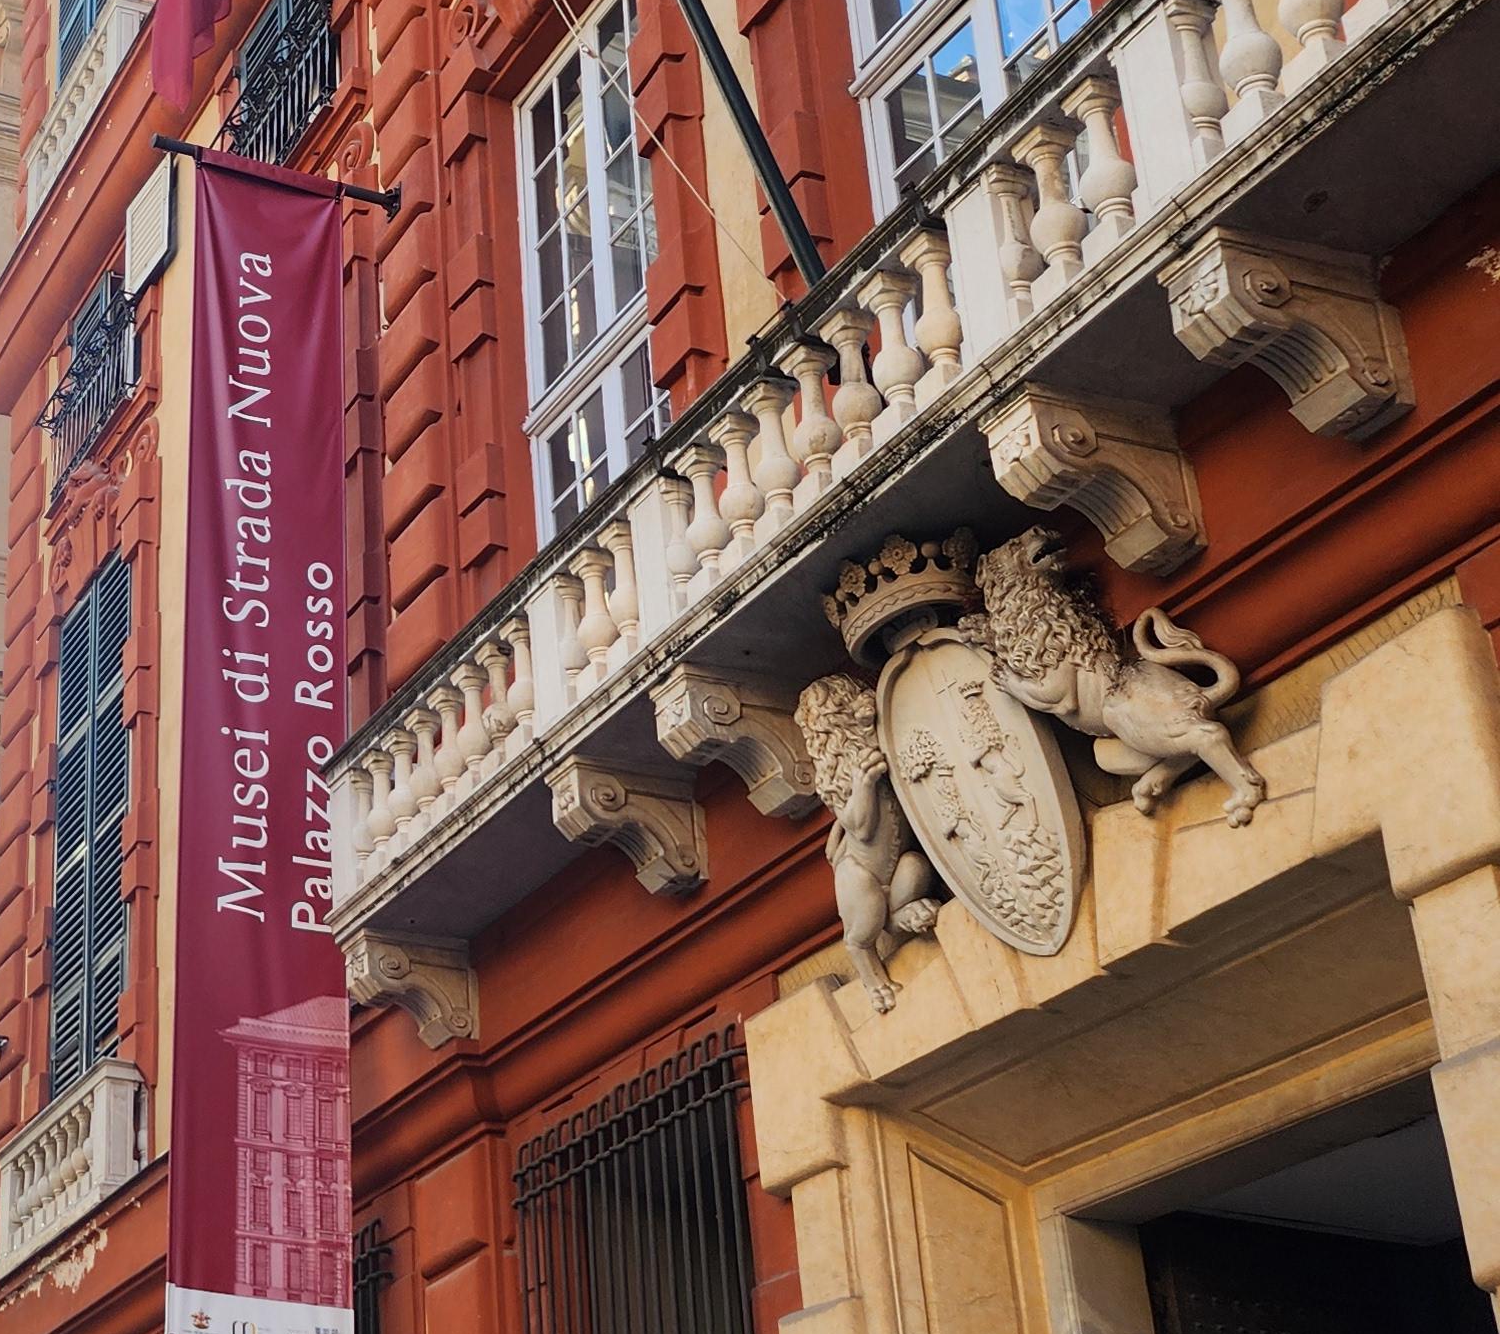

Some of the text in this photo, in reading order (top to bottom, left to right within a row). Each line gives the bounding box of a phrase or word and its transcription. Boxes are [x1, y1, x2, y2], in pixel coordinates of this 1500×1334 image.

[217, 251, 272, 923] Musei di Strada Nuova
[291, 562, 334, 933] Palazzo Rosso
